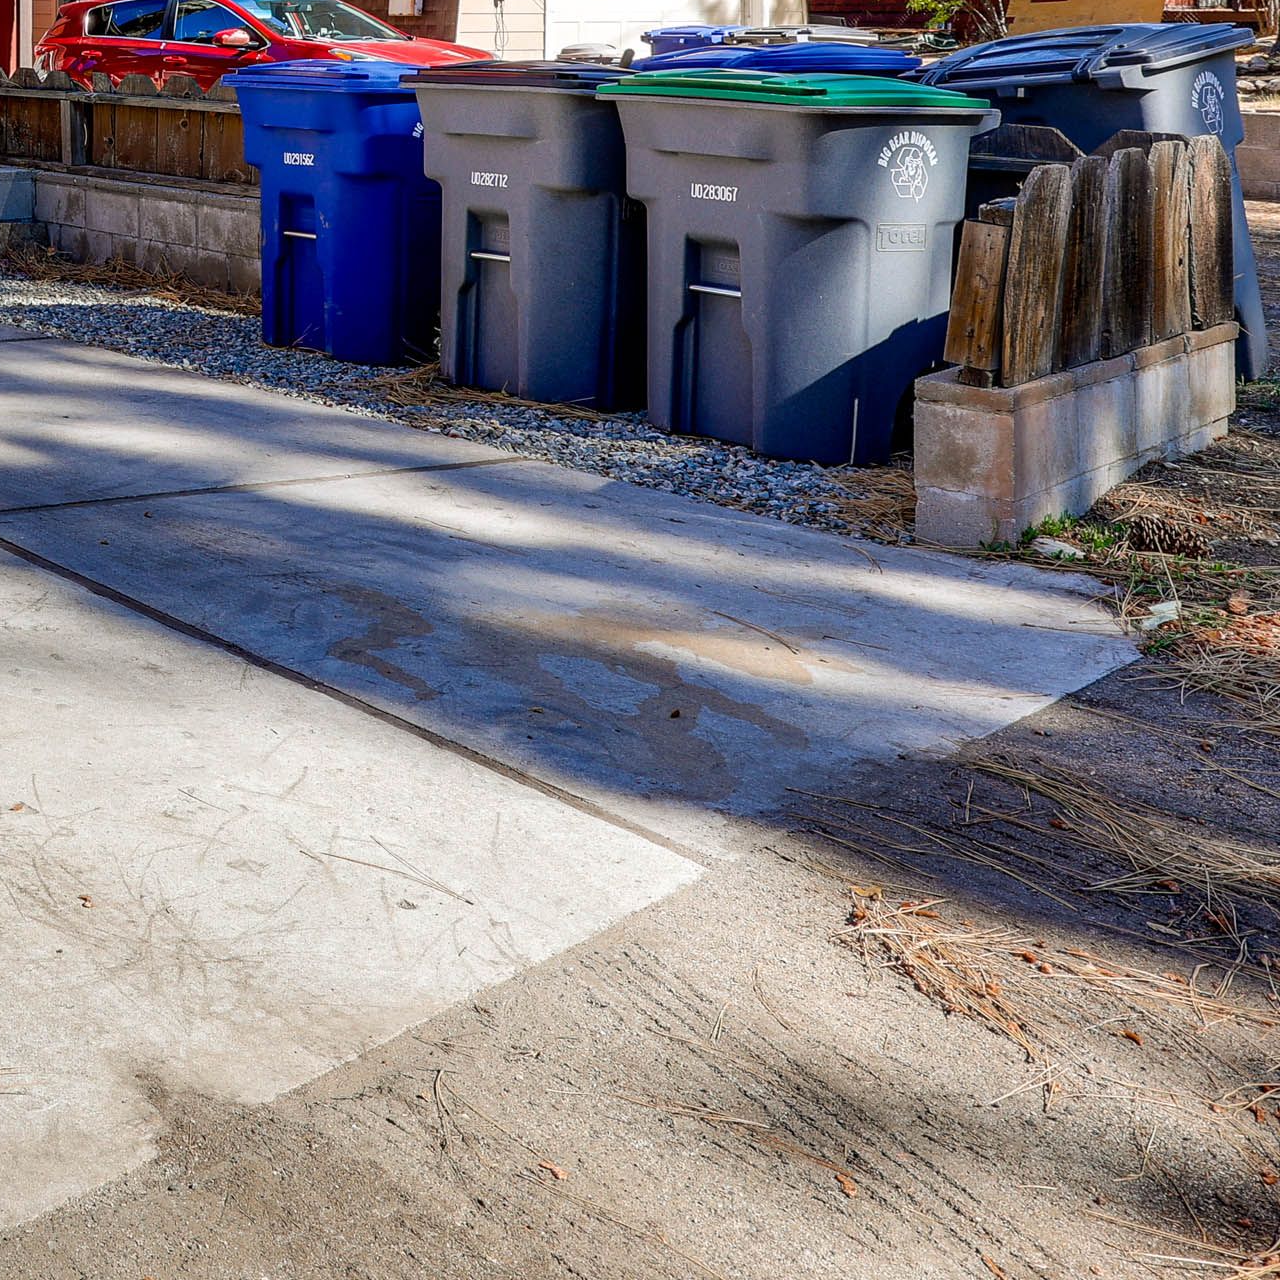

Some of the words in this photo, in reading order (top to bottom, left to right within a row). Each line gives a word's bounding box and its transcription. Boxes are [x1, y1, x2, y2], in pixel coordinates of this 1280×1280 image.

[412, 122, 424, 138] BIG
[877, 146, 892, 168] BIG
[888, 131, 910, 151] BEAR
[910, 131, 939, 166] DISPOSAL
